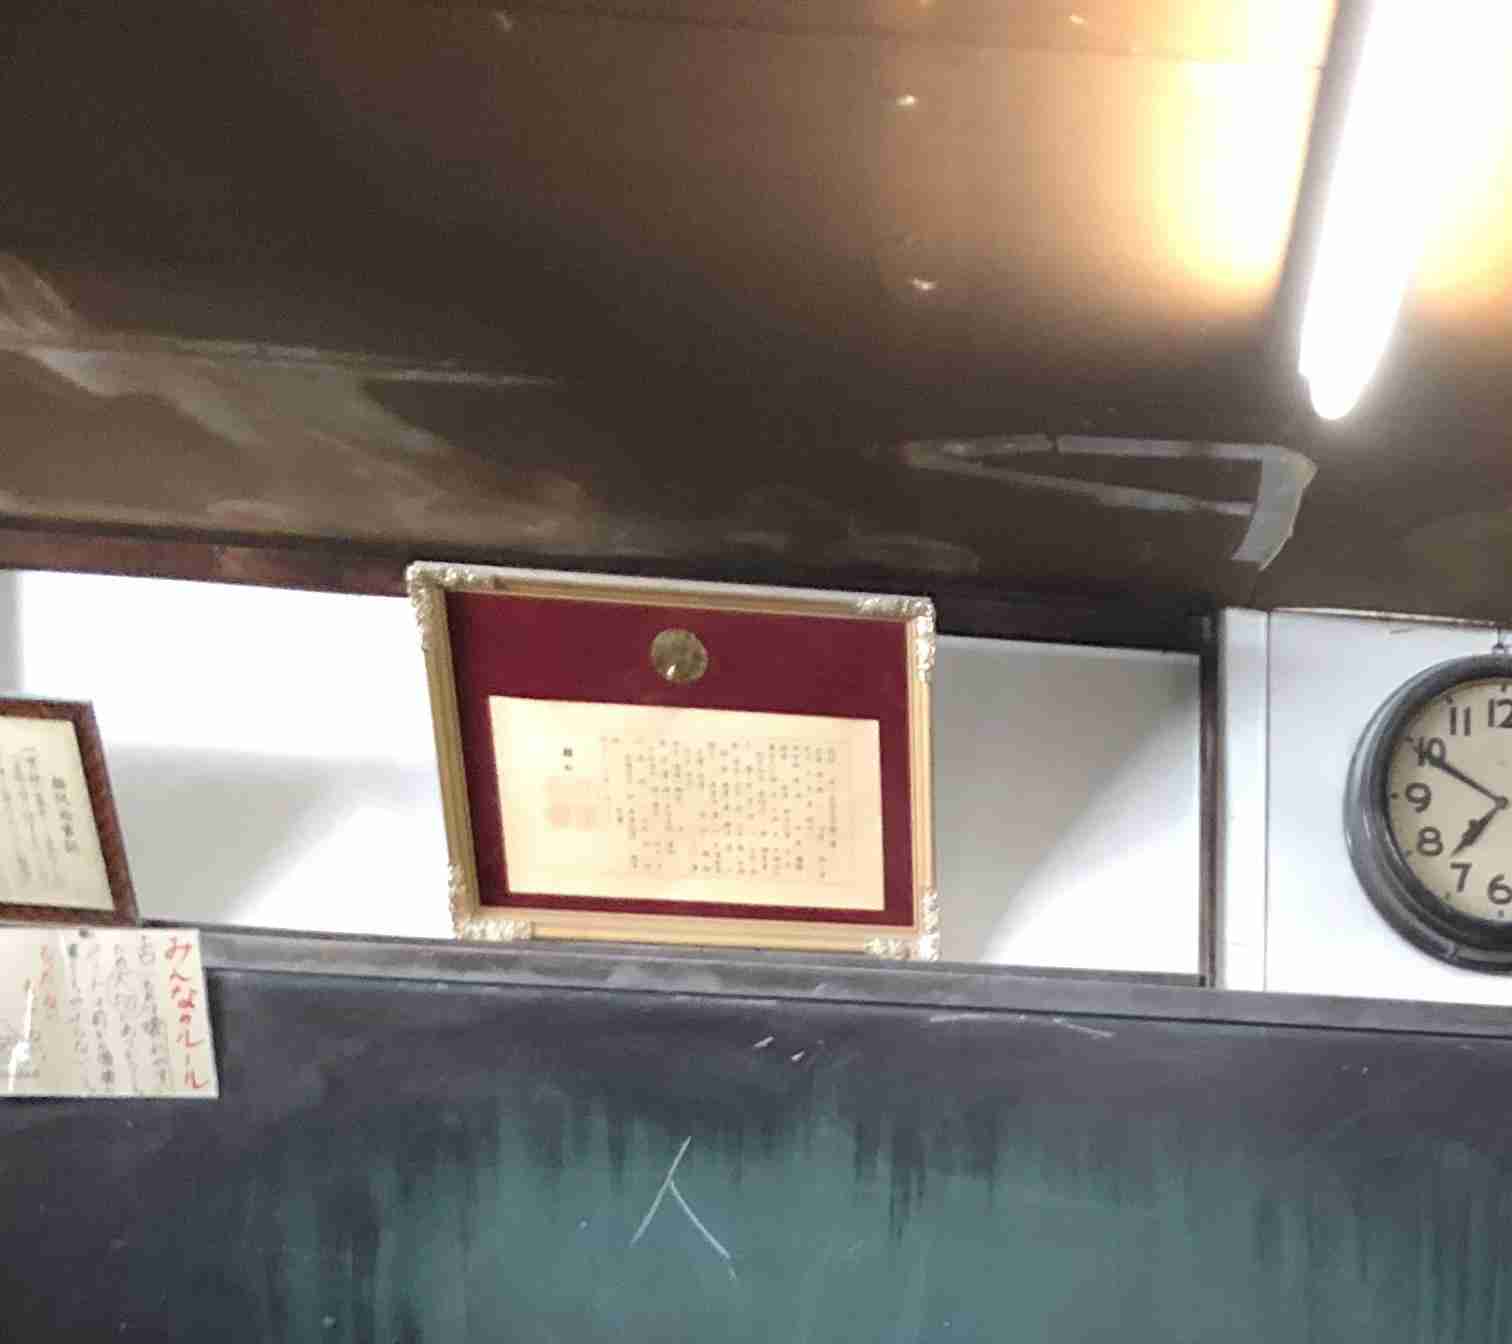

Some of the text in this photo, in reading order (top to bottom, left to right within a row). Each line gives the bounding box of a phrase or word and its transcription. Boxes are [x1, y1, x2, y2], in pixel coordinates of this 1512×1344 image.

[1449, 706, 1471, 736] 11
[1415, 737, 1447, 767] 10
[1404, 782, 1432, 813] 9
[1416, 826, 1444, 857] 8
[1450, 862, 1472, 893] 7
